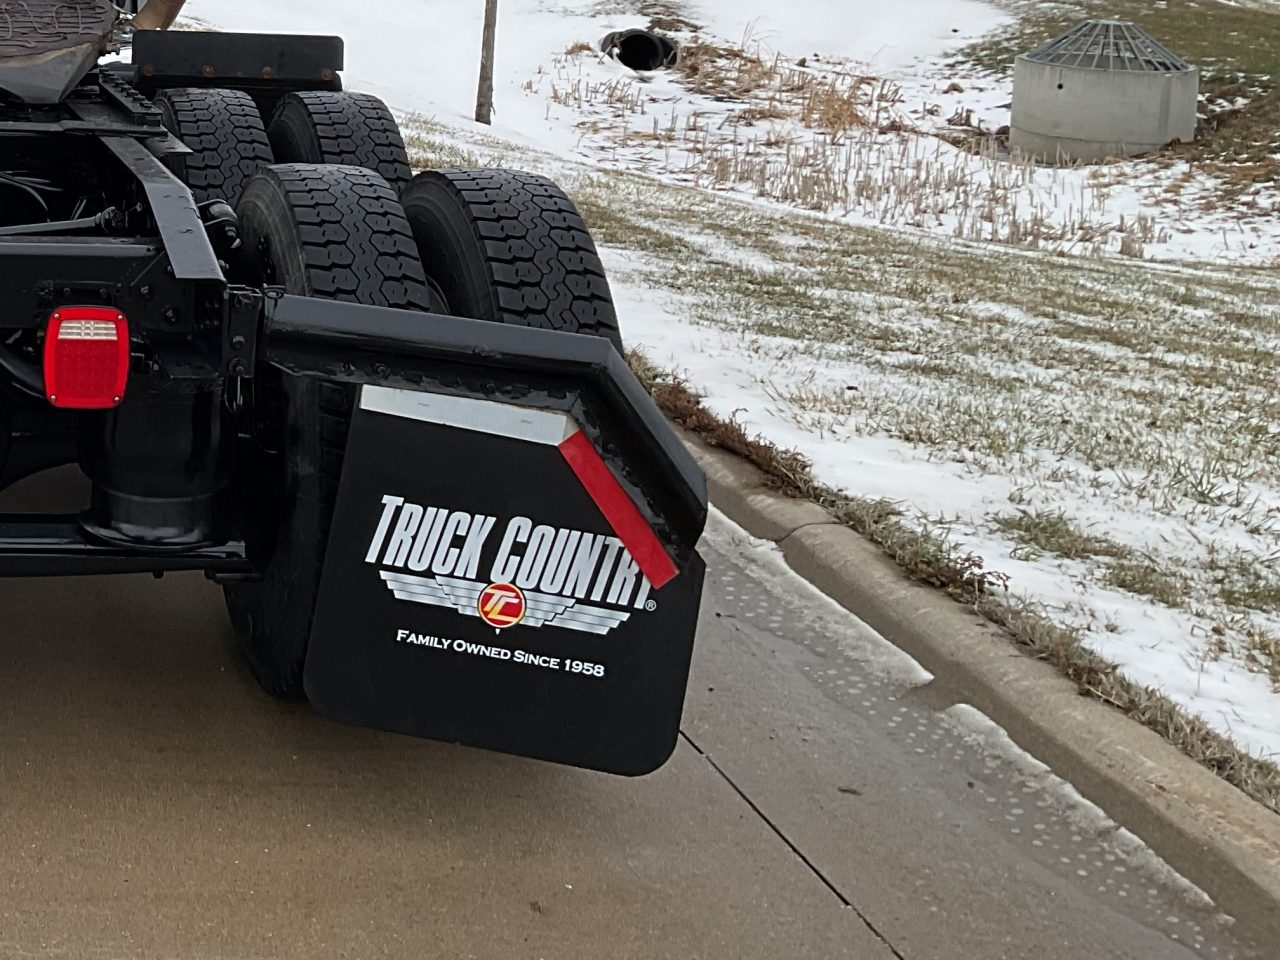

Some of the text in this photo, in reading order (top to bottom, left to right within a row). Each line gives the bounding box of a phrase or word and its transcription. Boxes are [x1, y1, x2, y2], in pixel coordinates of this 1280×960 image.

[364, 494, 497, 580] TRUCK
[396, 629, 606, 677] FAMILY OWNED SINCE 1958
